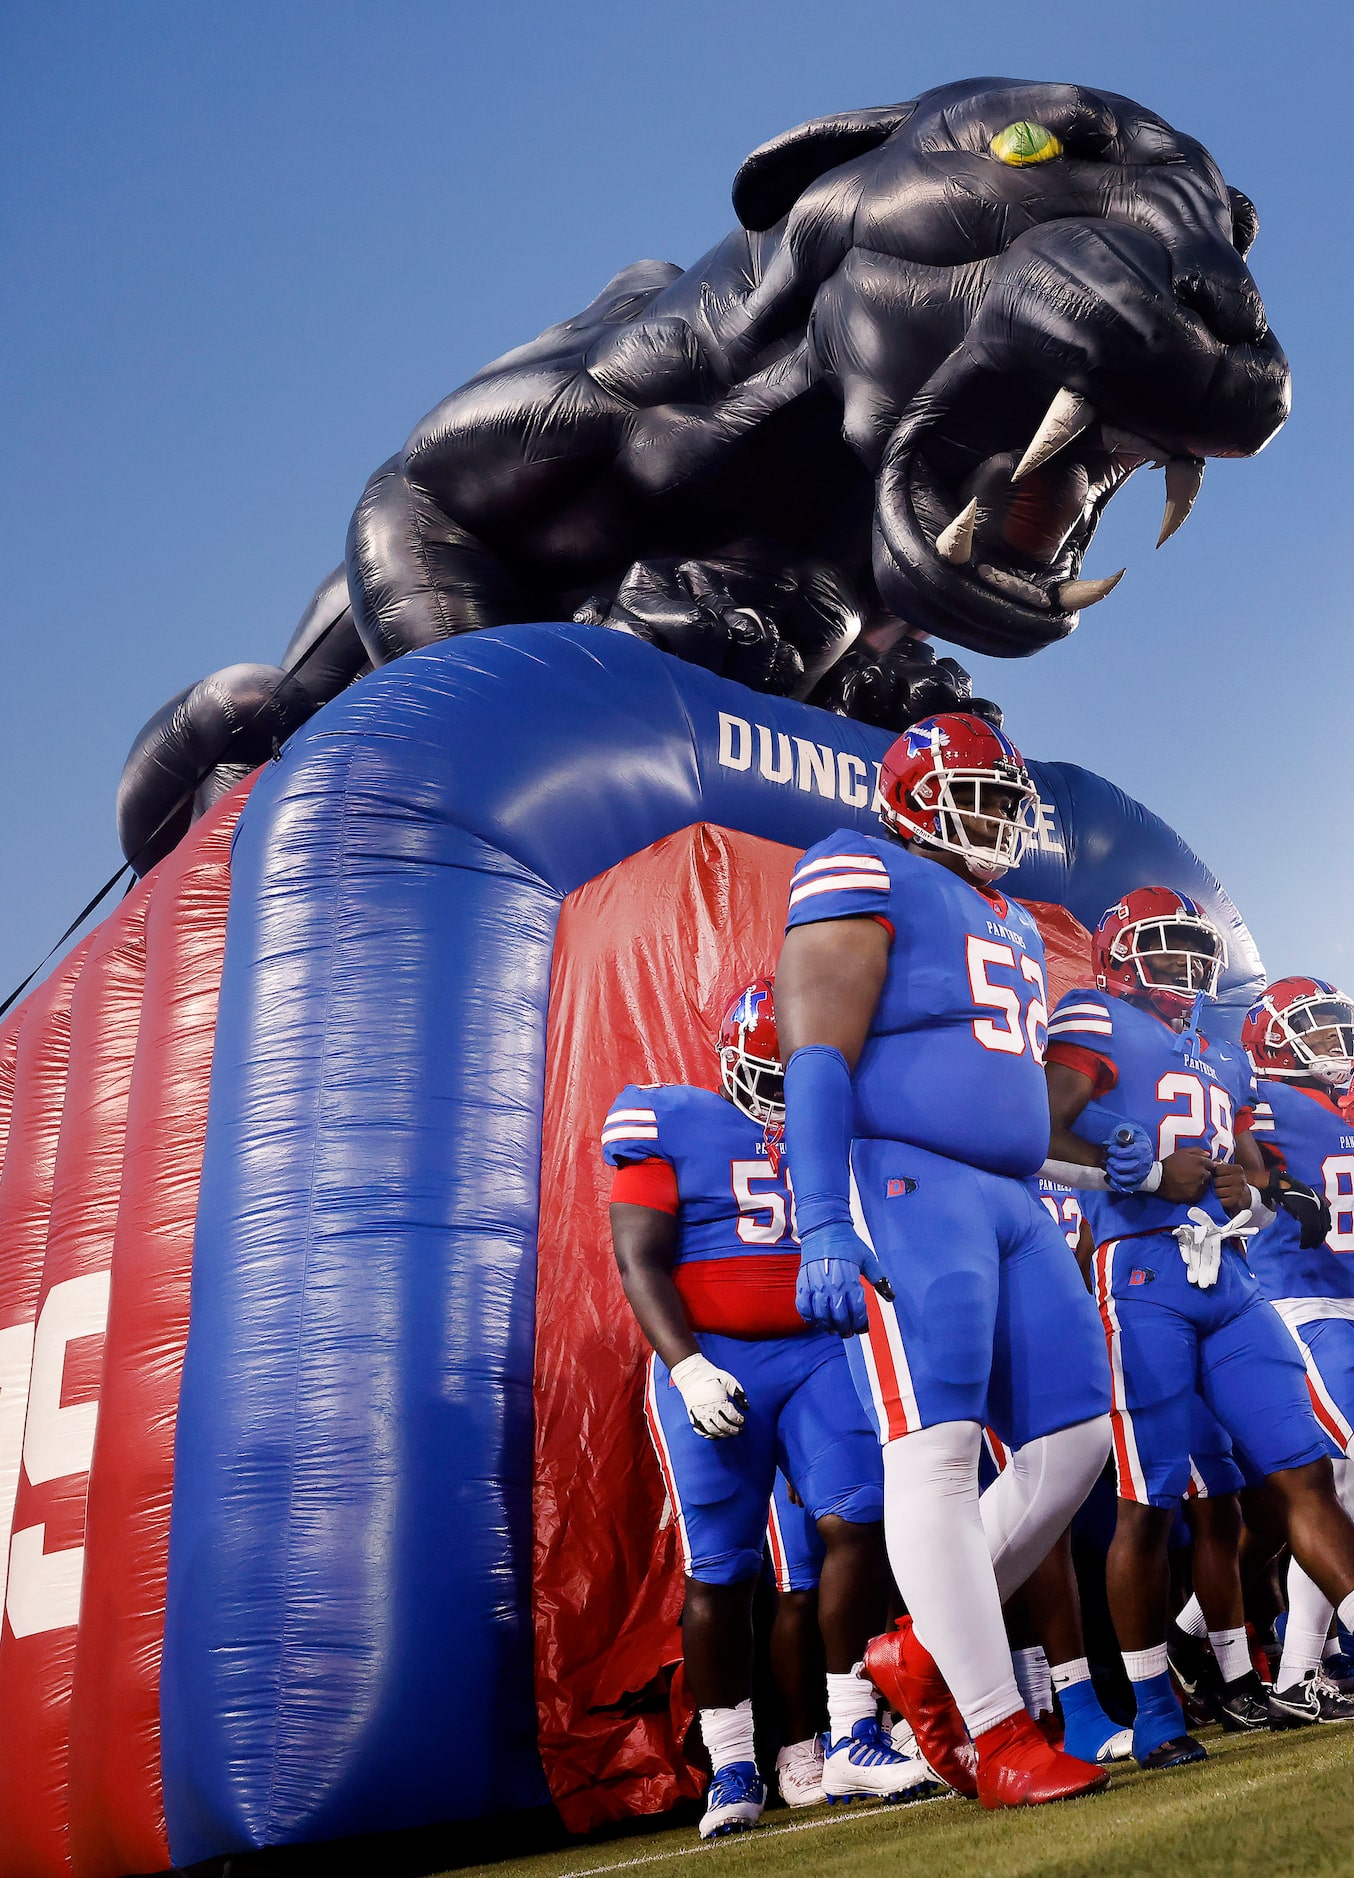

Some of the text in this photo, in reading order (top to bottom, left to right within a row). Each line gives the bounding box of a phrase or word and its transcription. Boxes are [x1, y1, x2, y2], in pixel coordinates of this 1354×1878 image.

[965, 933, 1048, 1068] 52
[1156, 1071, 1236, 1165] 28
[731, 1159, 801, 1246] 5
